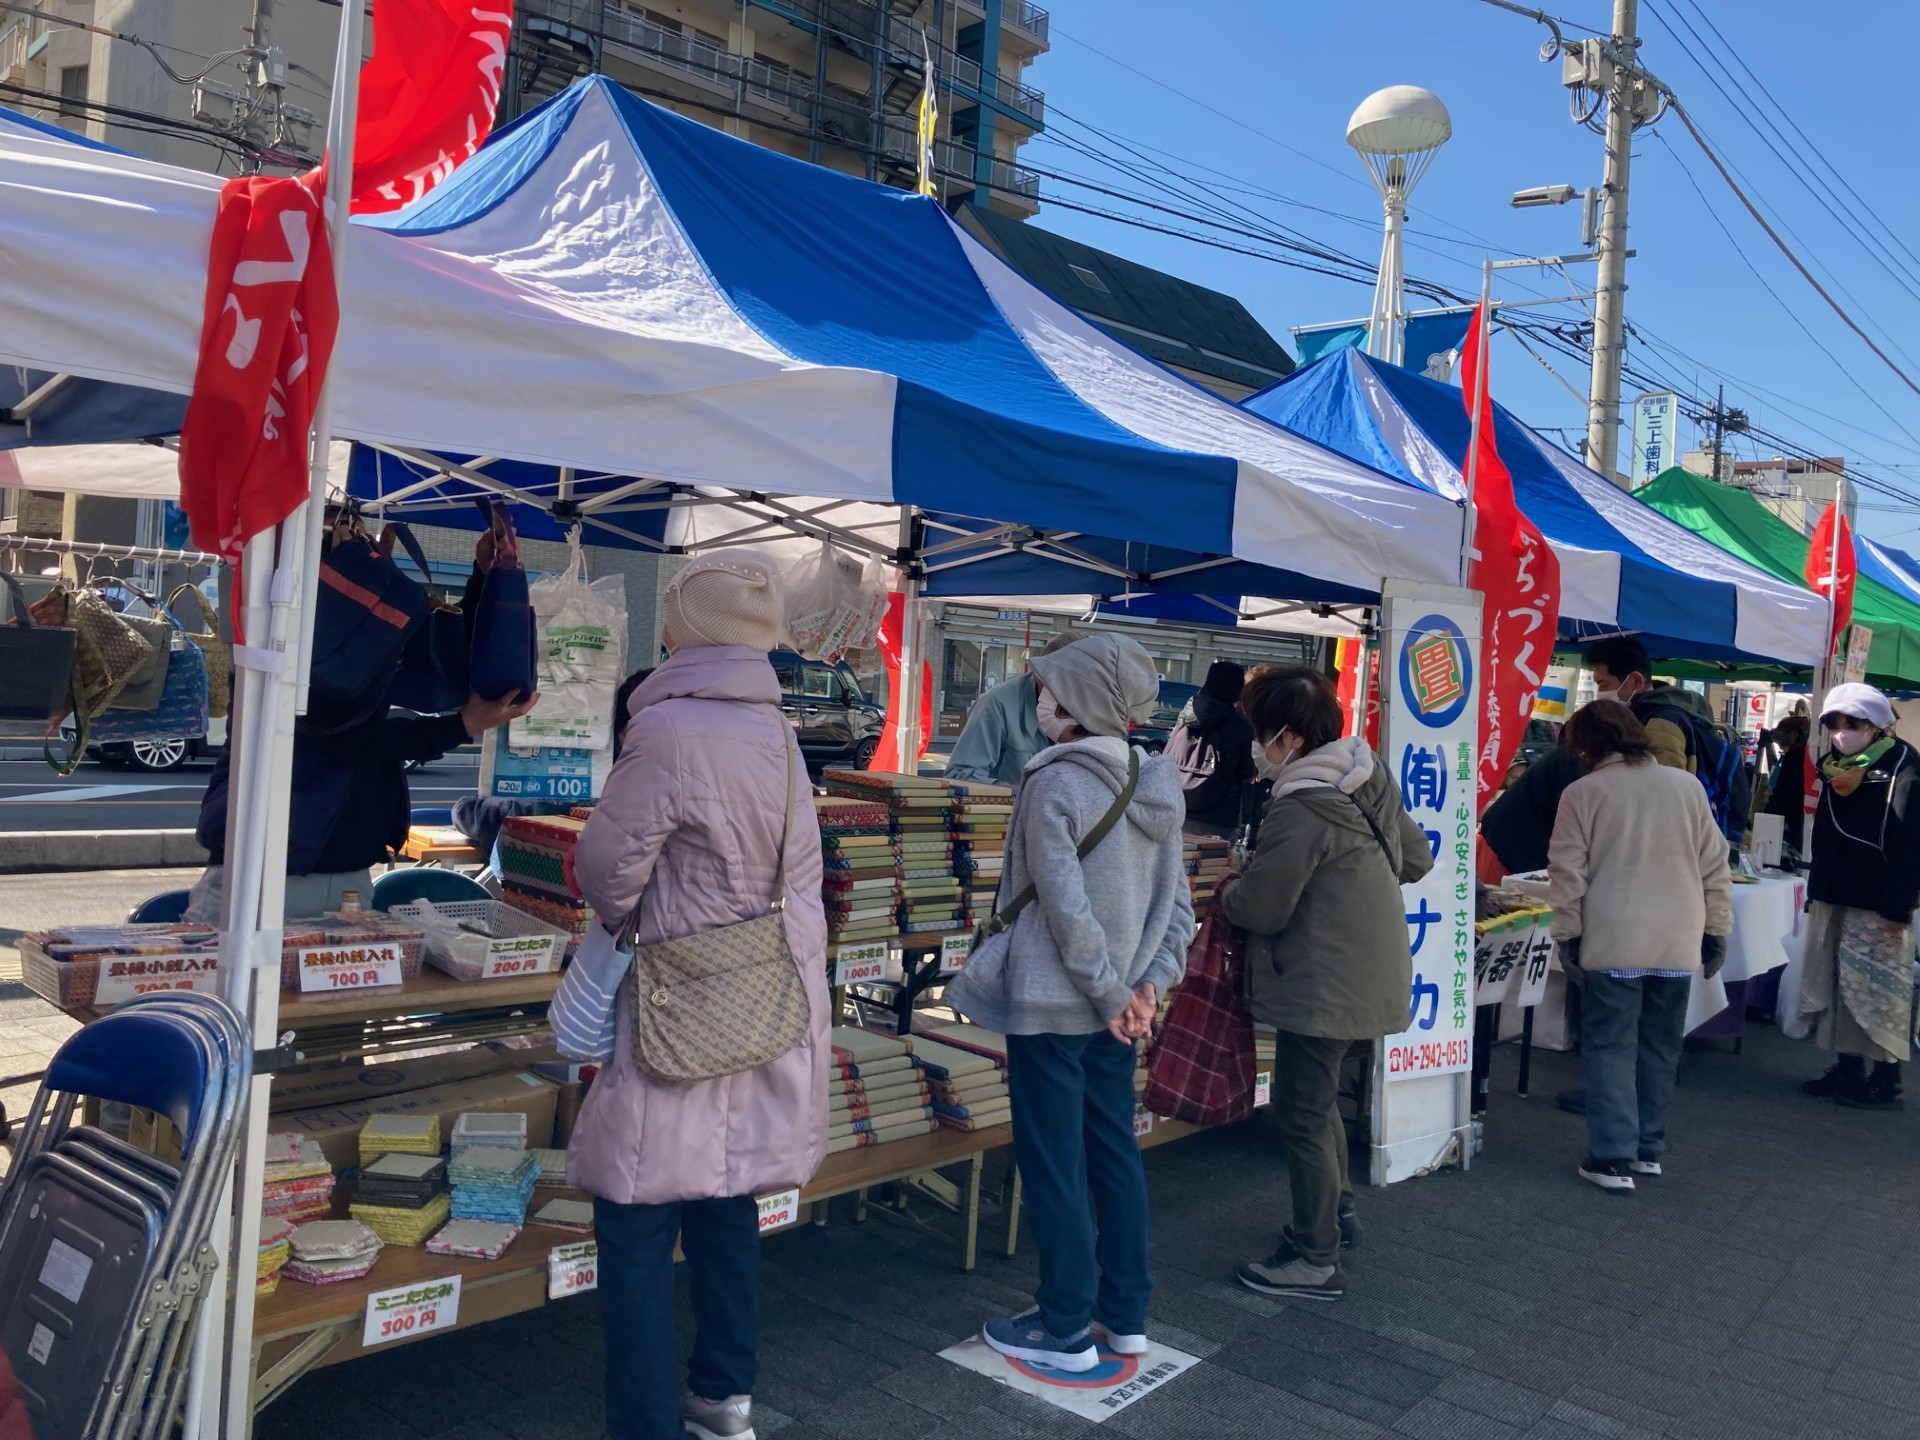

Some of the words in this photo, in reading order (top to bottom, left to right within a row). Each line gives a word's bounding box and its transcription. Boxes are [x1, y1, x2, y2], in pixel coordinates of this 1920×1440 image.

[1645, 415, 1662, 474] 三上歯科
[1415, 640, 1461, 706] 畳
[547, 778, 581, 796] 100
[490, 939, 552, 953] ミニたたみ
[1452, 909, 1468, 1029] さわやか気分
[1403, 1040, 1468, 1072] 04-2942-0513
[375, 1284, 454, 1311] ミニたたみ
